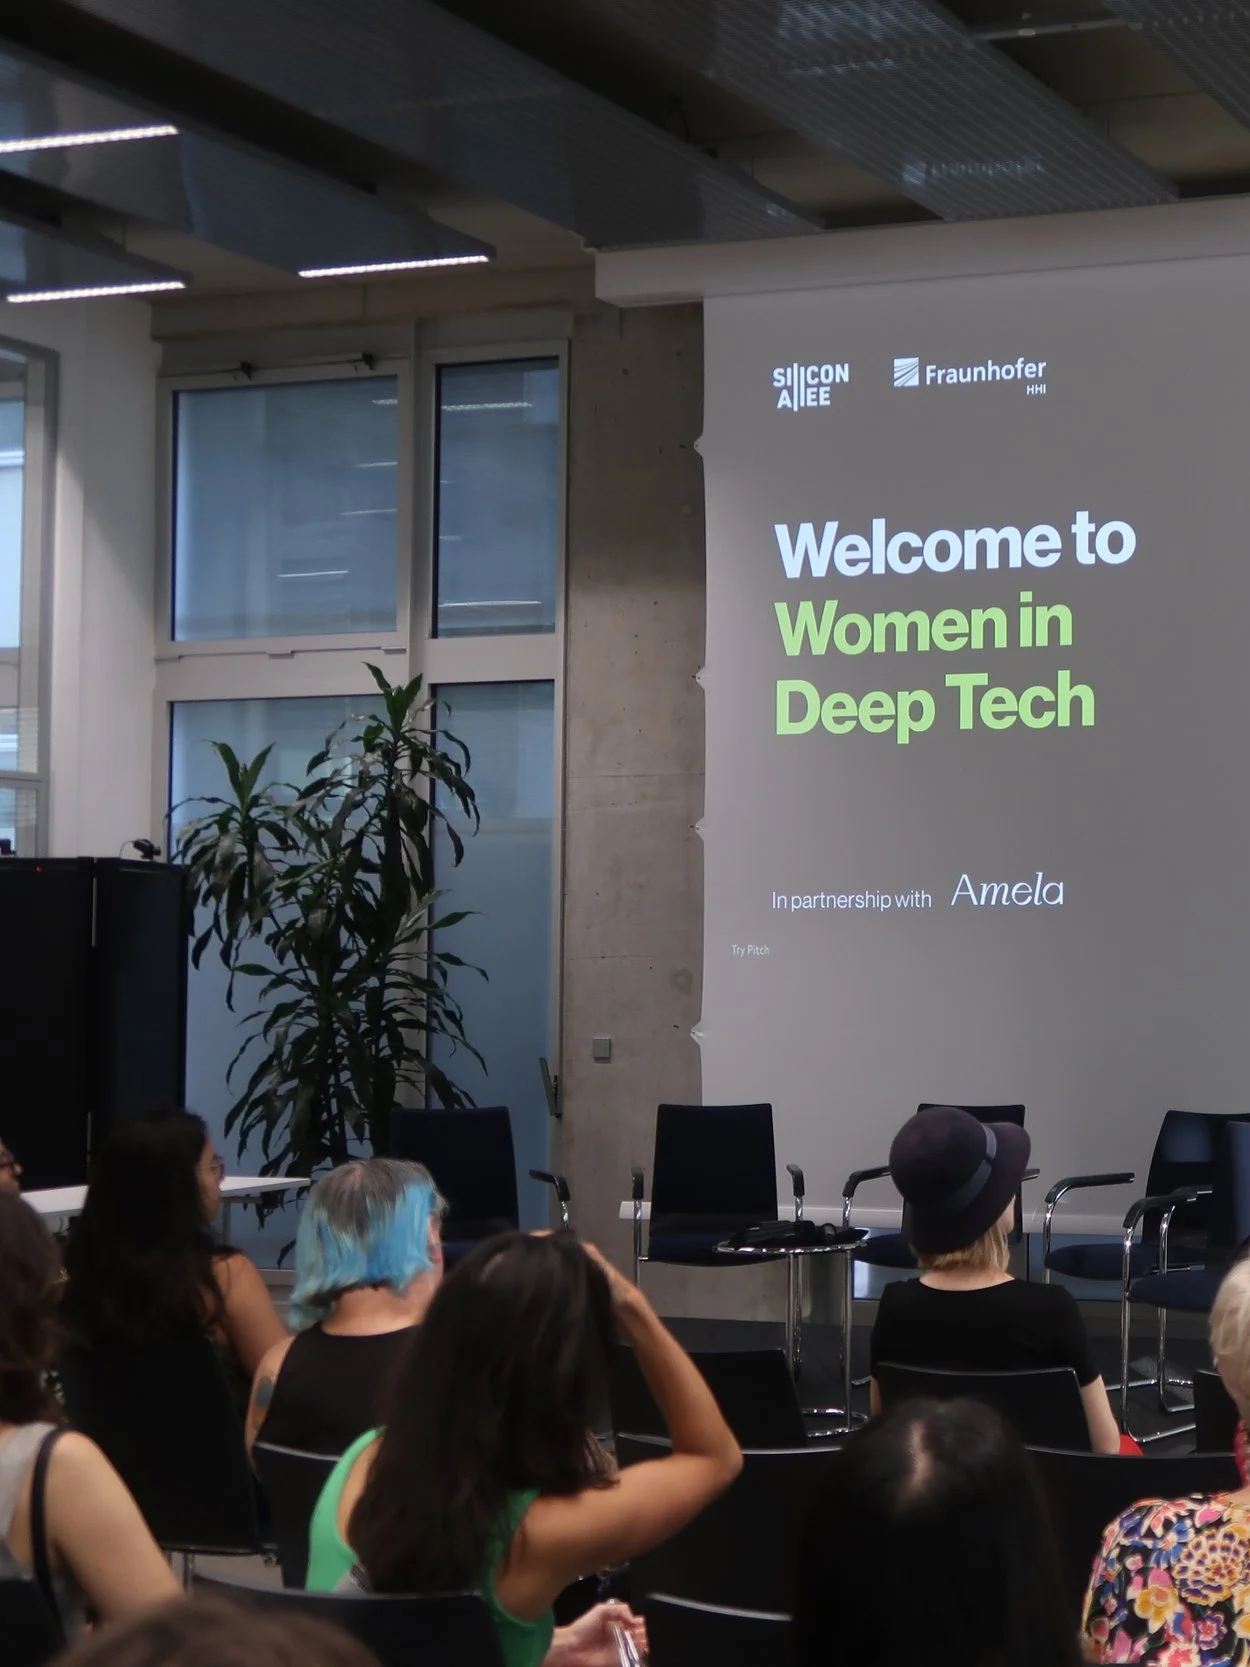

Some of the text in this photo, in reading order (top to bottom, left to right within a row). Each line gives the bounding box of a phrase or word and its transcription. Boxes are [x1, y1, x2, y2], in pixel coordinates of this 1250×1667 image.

[925, 357, 1047, 386] Fraunhofer
[1026, 383, 1047, 396] HHI
[774, 510, 1137, 579] Welcome to
[774, 590, 1073, 656] Women in
[776, 669, 1095, 744] Deep Tech
[772, 890, 932, 912] In partnership with
[951, 872, 1065, 906] Amela
[732, 944, 770, 958] Try Pitch
